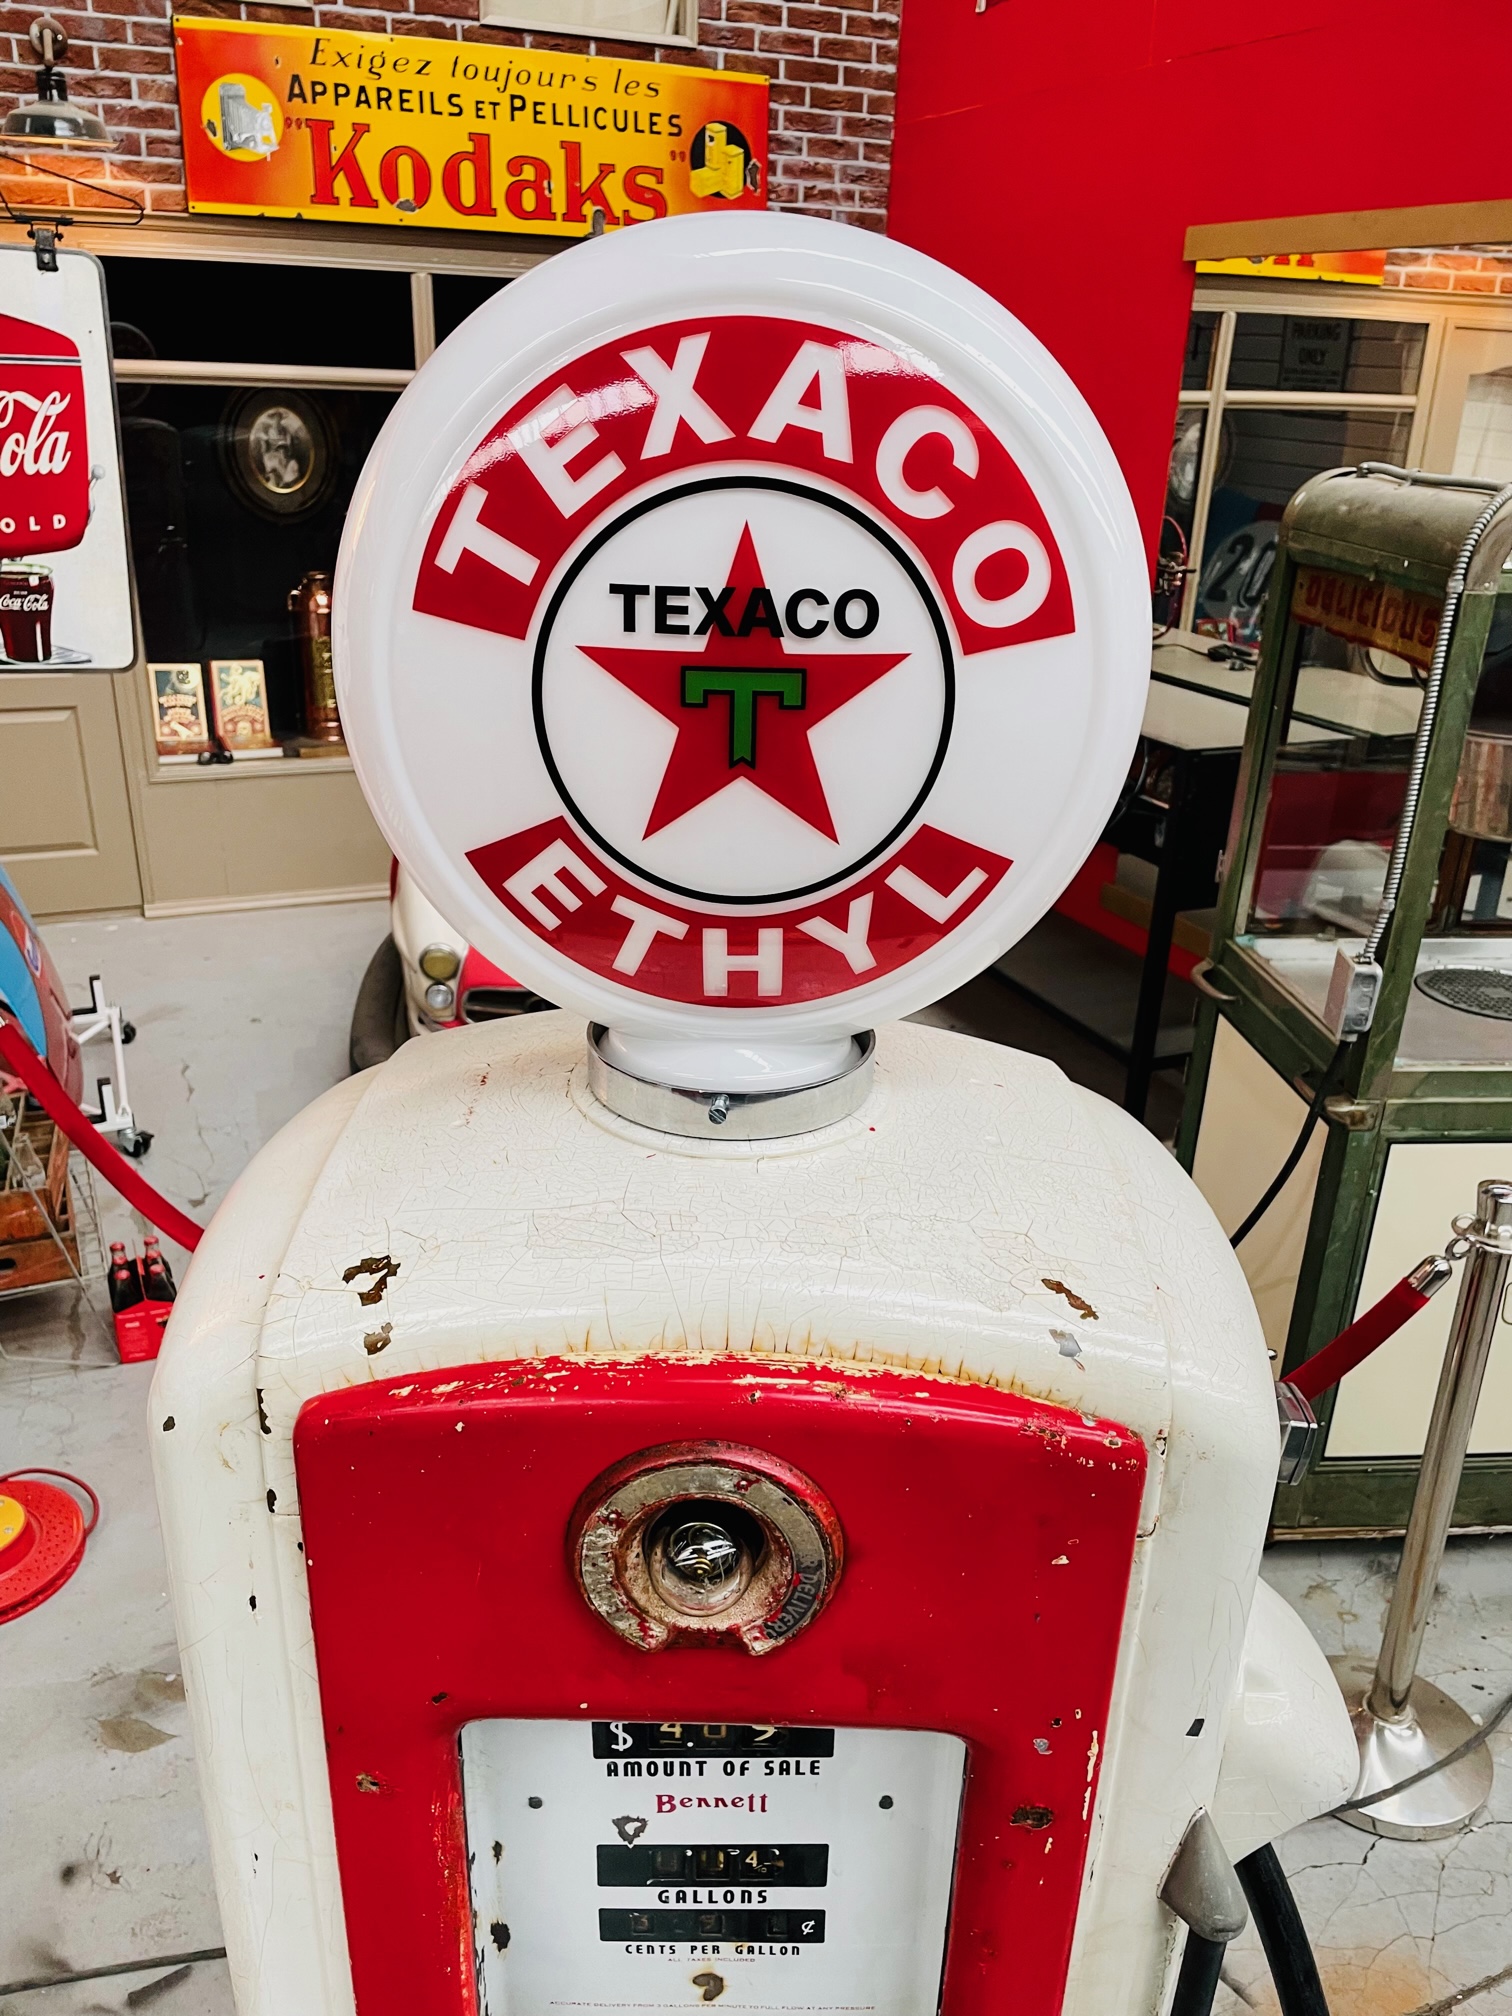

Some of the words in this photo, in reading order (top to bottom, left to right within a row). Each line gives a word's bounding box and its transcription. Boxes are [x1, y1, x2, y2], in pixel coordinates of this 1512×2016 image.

[309, 38, 432, 80] Exigez
[451, 56, 598, 93] toujours
[614, 68, 661, 97] les
[287, 74, 464, 117] APPAREILS
[475, 100, 500, 120] ET
[510, 94, 683, 137] PELLICULES
[434, 331, 1051, 628] TEXACO
[609, 583, 880, 639] TEXACO
[1305, 575, 1441, 647] DELICIOUS
[681, 666, 807, 770] T
[502, 838, 989, 997] ETHYL
[606, 1760, 707, 1777] AMOUNT
[723, 1760, 750, 1776] OF
[764, 1759, 821, 1776] SALE
[655, 1793, 768, 1814] Bennett
[657, 1889, 768, 1904] GALLONS
[625, 1944, 676, 1955] CENTS
[690, 1944, 720, 1955] PER
[734, 1944, 800, 1956] GALLON
